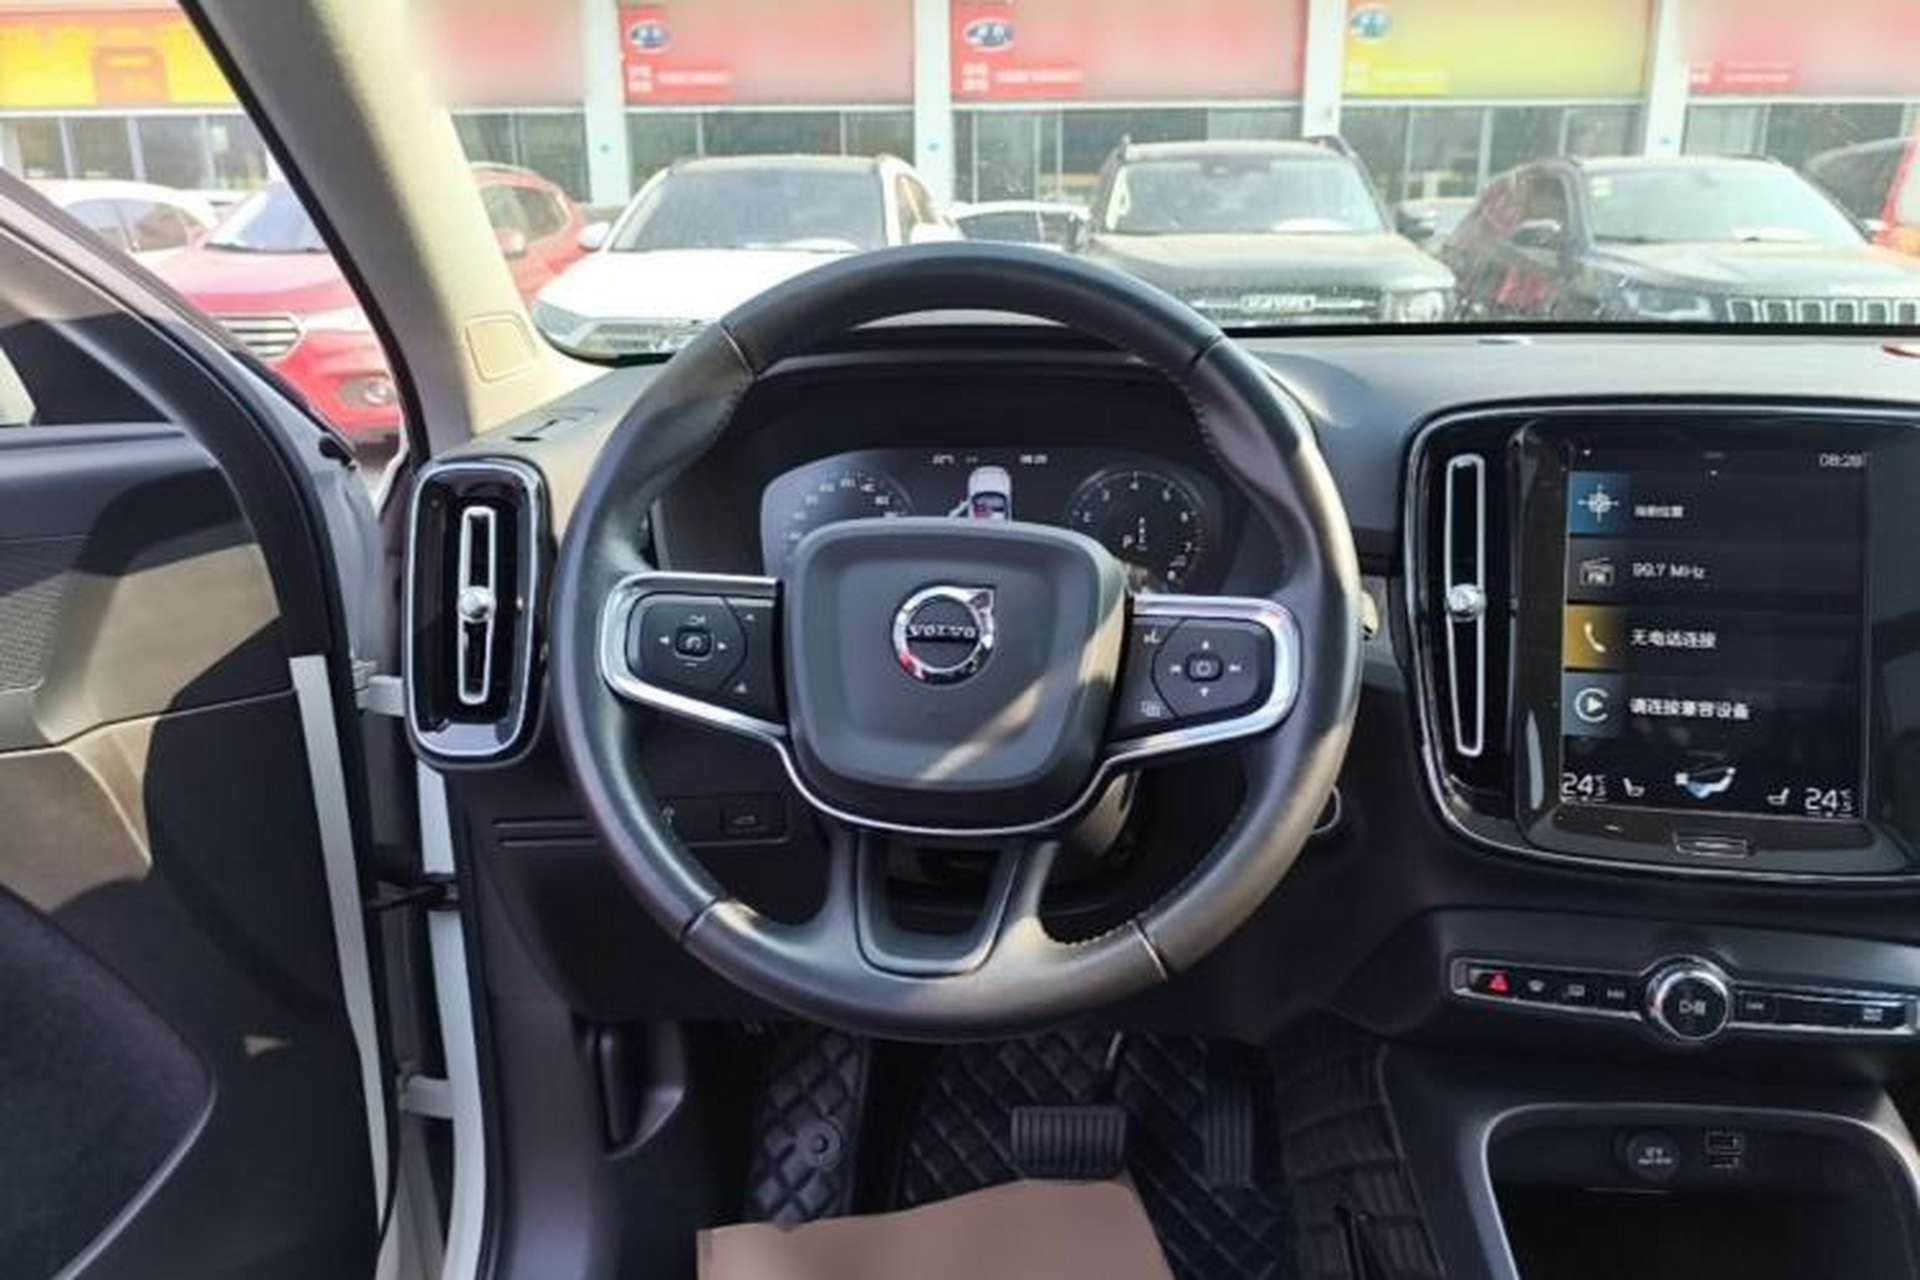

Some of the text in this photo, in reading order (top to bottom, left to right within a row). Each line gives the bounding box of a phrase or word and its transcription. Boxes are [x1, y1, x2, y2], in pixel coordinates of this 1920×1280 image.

[907, 624, 977, 639] VOLVO
[1630, 628, 1717, 650] 无电话连接
